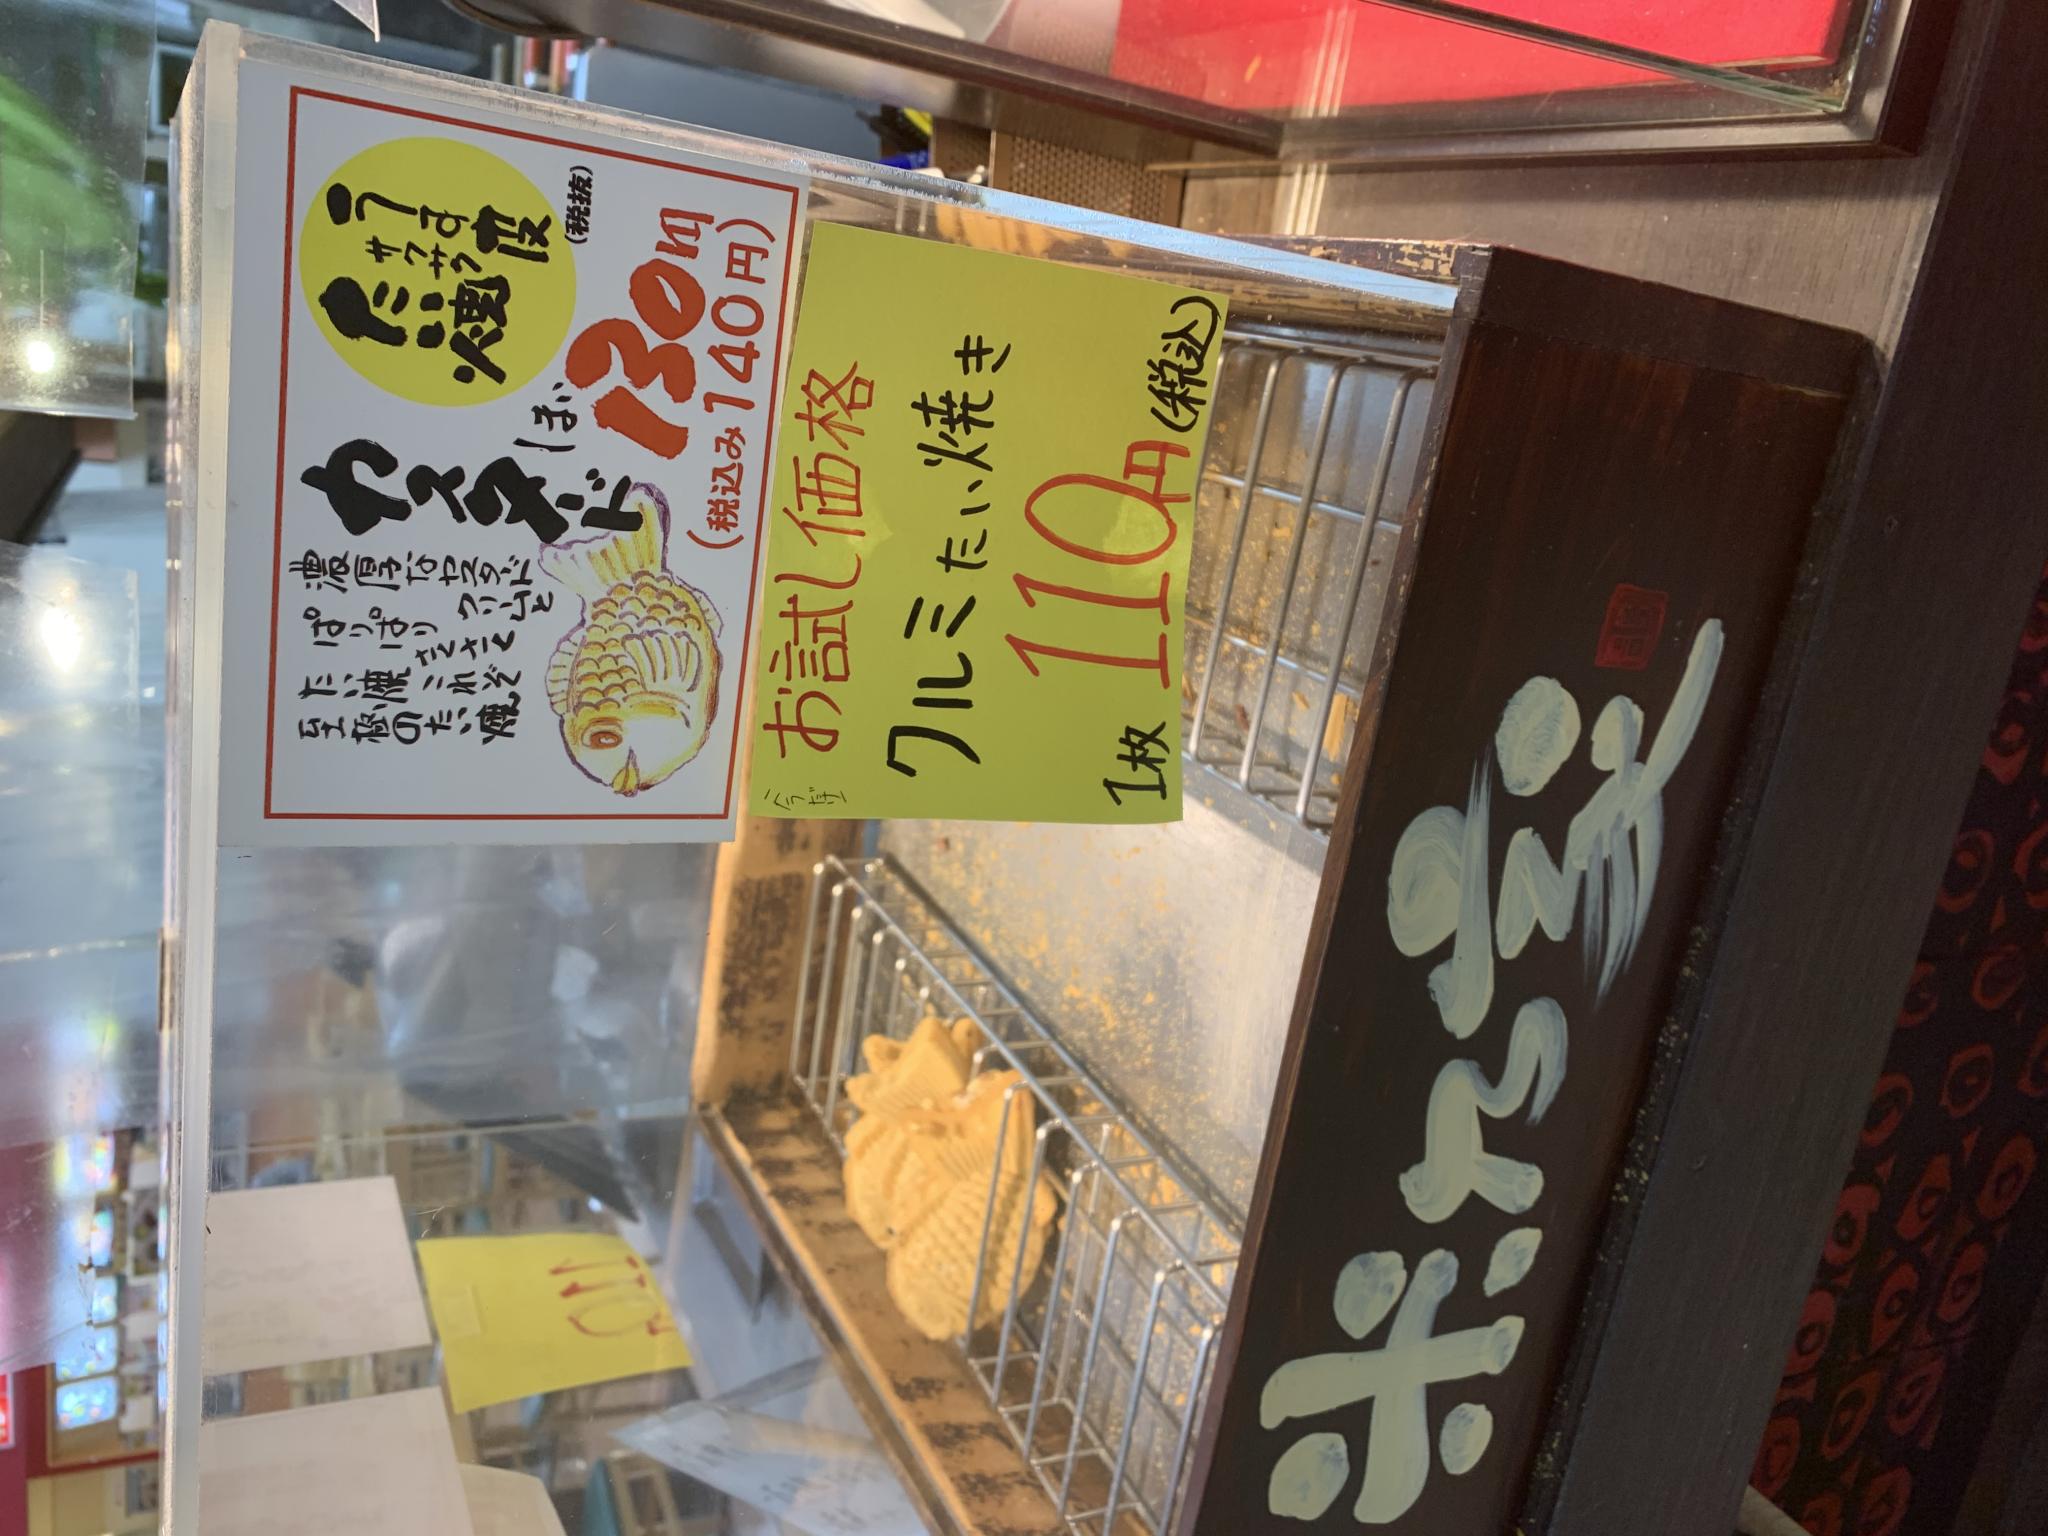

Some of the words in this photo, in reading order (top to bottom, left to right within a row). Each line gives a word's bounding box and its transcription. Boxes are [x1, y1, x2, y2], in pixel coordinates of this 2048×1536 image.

[564, 165, 593, 244] (税抜)
[365, 235, 482, 280] サクサク
[300, 438, 643, 545] カスタード
[761, 360, 875, 759] お試し価格
[1003, 440, 1192, 690] 110円
[302, 605, 438, 648] ぱりぱり
